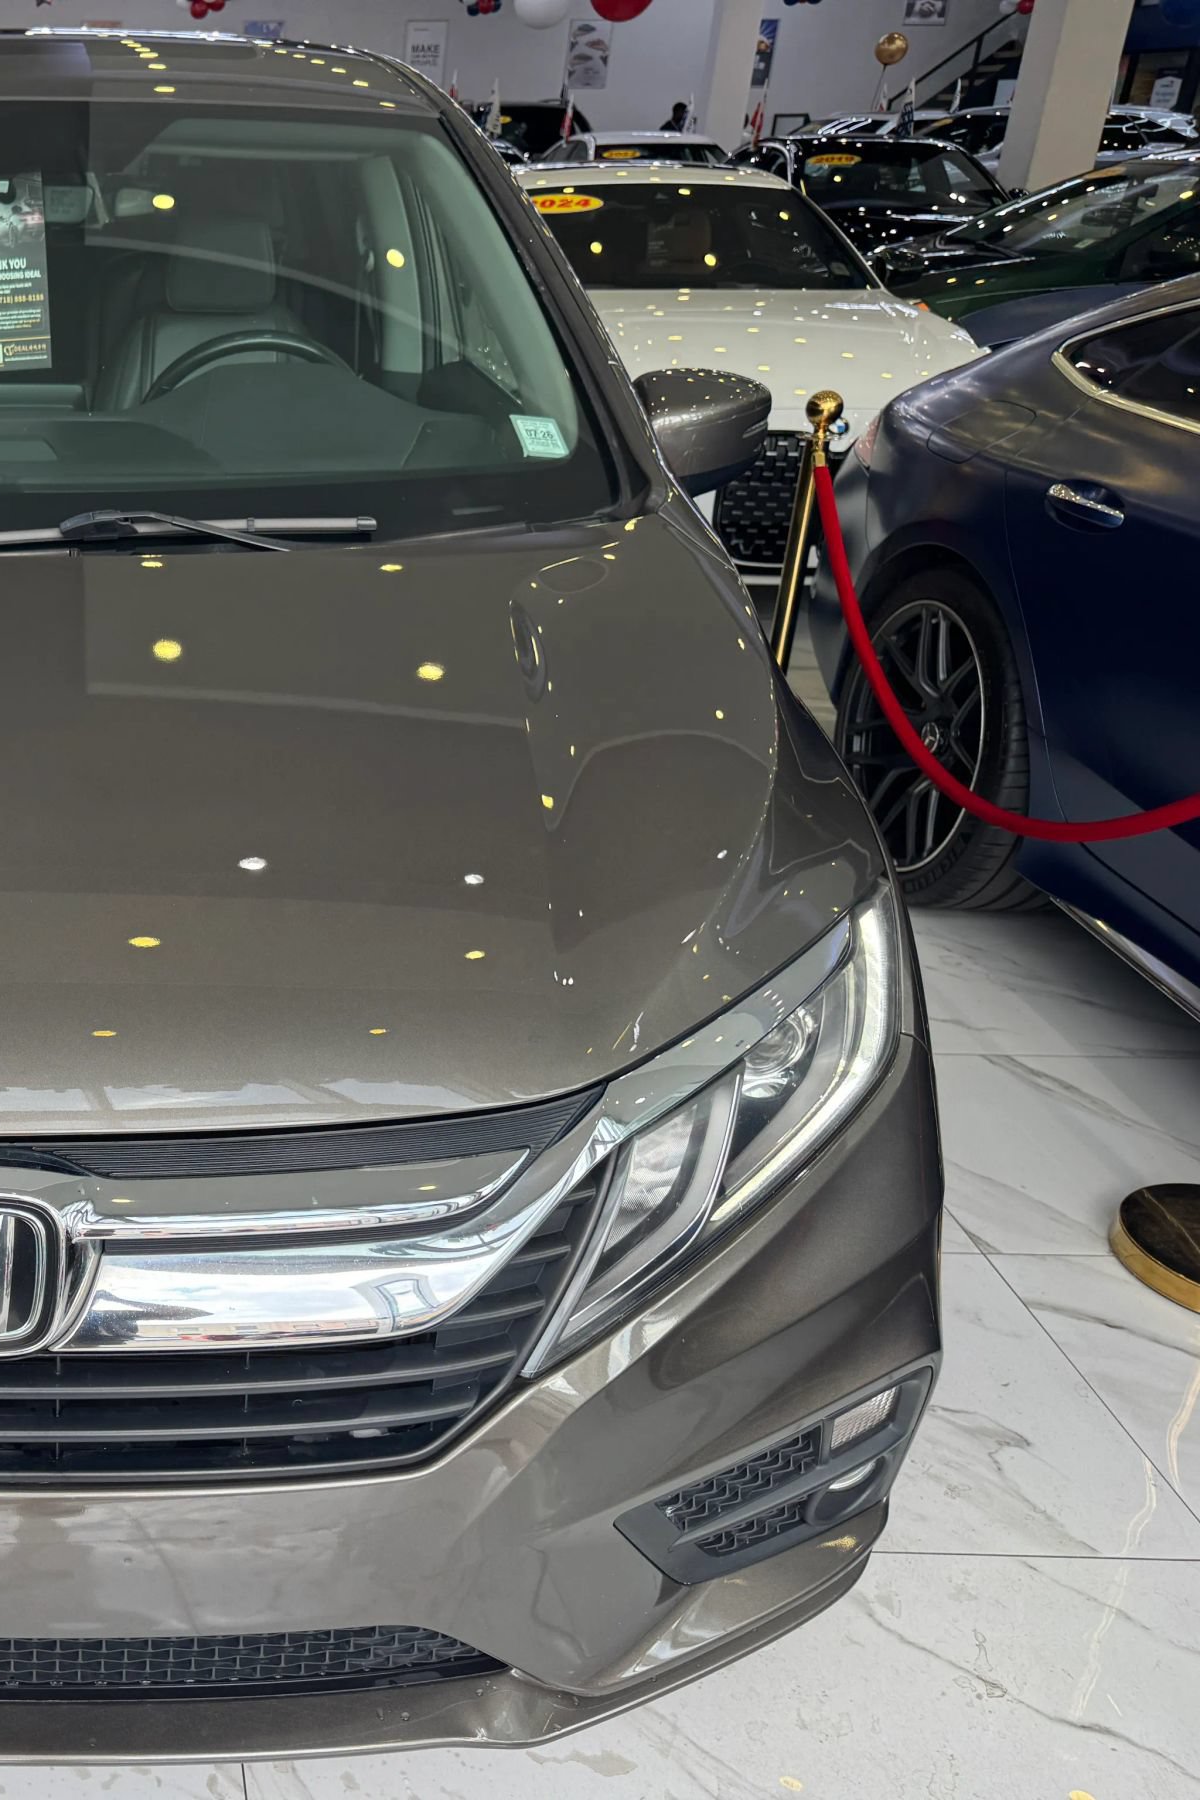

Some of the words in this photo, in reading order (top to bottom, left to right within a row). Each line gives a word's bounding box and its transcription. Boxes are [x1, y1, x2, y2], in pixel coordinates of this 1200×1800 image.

[411, 43, 441, 54] MAKE
[532, 198, 592, 209] 024
[9, 257, 27, 270] YOU
[25, 269, 41, 279] IDEAL
